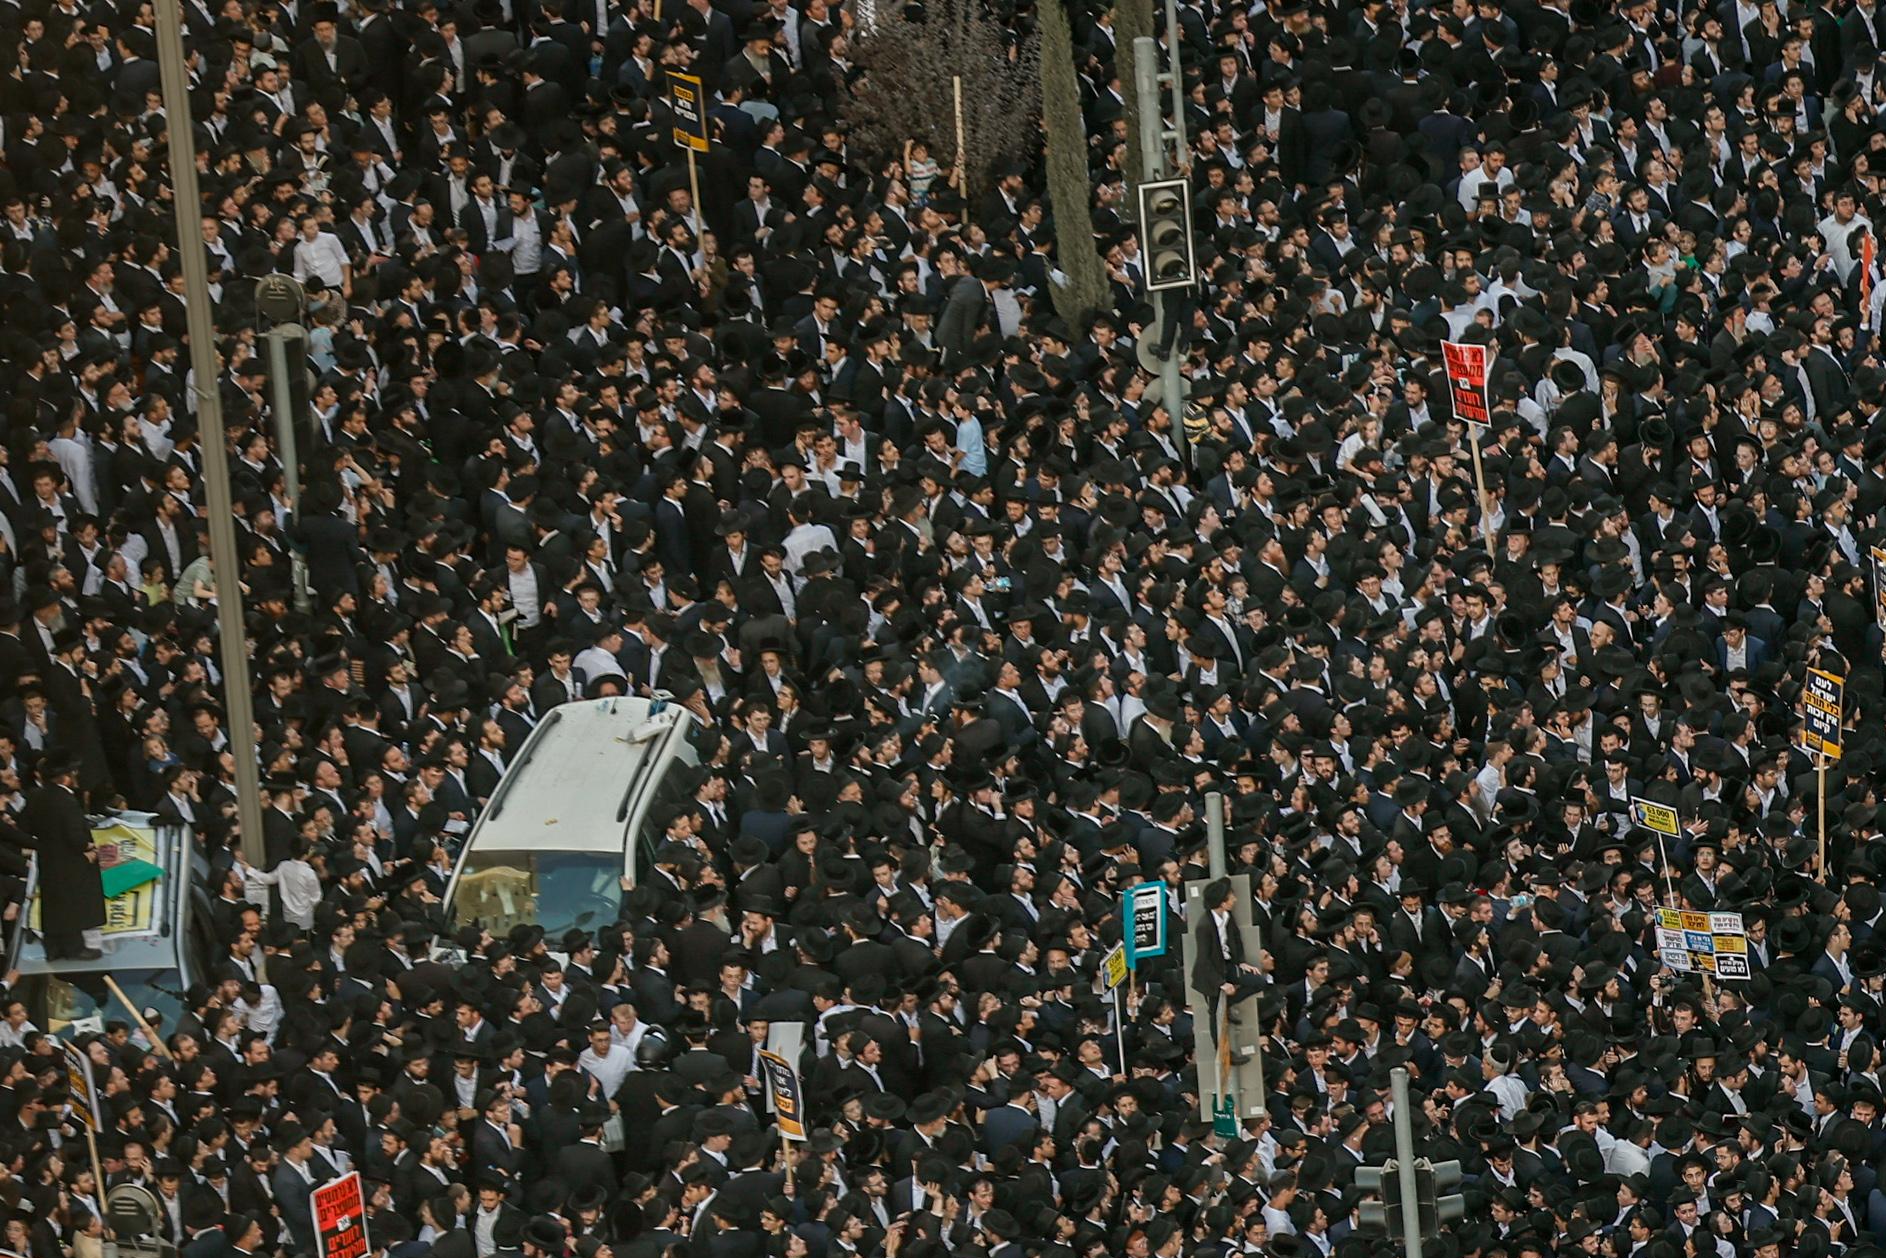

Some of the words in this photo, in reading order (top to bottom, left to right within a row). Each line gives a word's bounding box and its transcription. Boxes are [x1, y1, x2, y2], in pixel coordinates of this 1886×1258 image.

[1815, 676, 1832, 692] לעם
[1811, 683, 1836, 703] ישראל
[1804, 694, 1825, 709] תורה
[1826, 703, 1839, 716] בלי
[1806, 703, 1825, 720] זכות
[1813, 719, 1831, 734] קיום
[1825, 712, 1838, 728] אין
